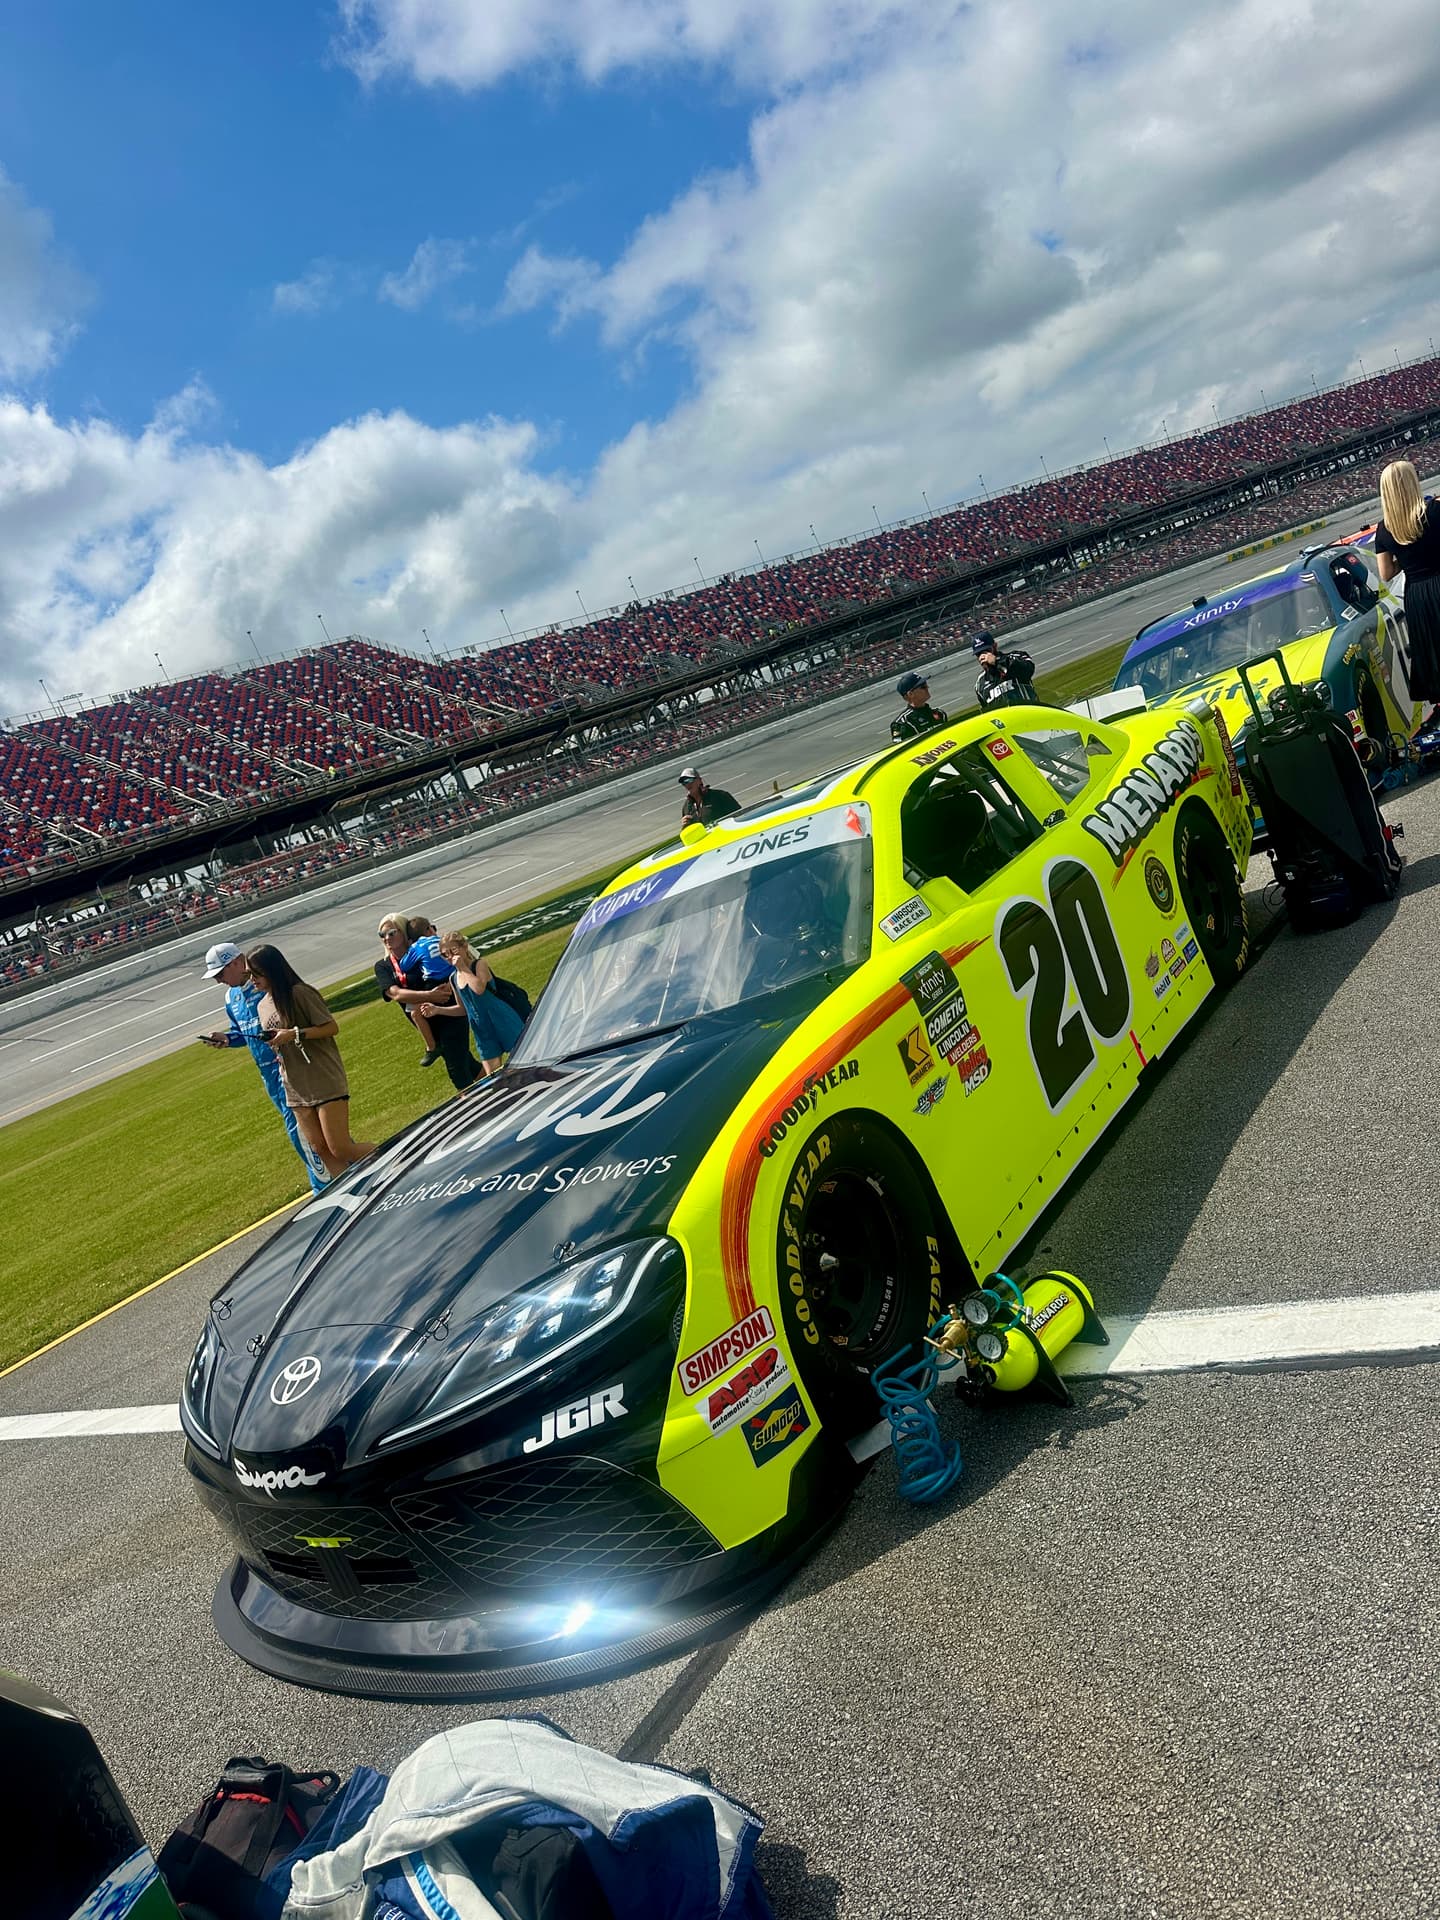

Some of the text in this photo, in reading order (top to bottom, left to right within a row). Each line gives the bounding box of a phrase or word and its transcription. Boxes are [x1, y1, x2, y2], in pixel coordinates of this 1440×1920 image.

[1183, 597, 1244, 629] xfinity
[1083, 722, 1203, 864] MENARDS
[727, 825, 810, 865] JONES
[586, 878, 662, 925] xfinity
[893, 909, 925, 934] RACE CAR
[894, 900, 920, 921] NASCAR
[918, 969, 946, 999] xfinity
[997, 858, 1131, 1112] 20
[928, 996, 964, 1039] COMETIC
[938, 1021, 970, 1057] LINCOLN
[950, 1033, 977, 1062] WELDERS
[964, 1064, 988, 1096] MSD
[758, 1059, 860, 1157] GOODYEAR
[371, 1175, 482, 1216] Bathtubs
[481, 1166, 549, 1192] and
[784, 1134, 831, 1345] GOODYEAR
[1031, 1293, 1069, 1333] MENARDS
[686, 1312, 767, 1389] SIMPSON
[708, 1347, 778, 1422] ARP
[712, 1394, 749, 1430] automotive
[766, 1364, 788, 1389] products
[522, 1383, 628, 1454] JGR
[755, 1404, 800, 1449] SUNOCO
[233, 1458, 326, 1495] Supra
